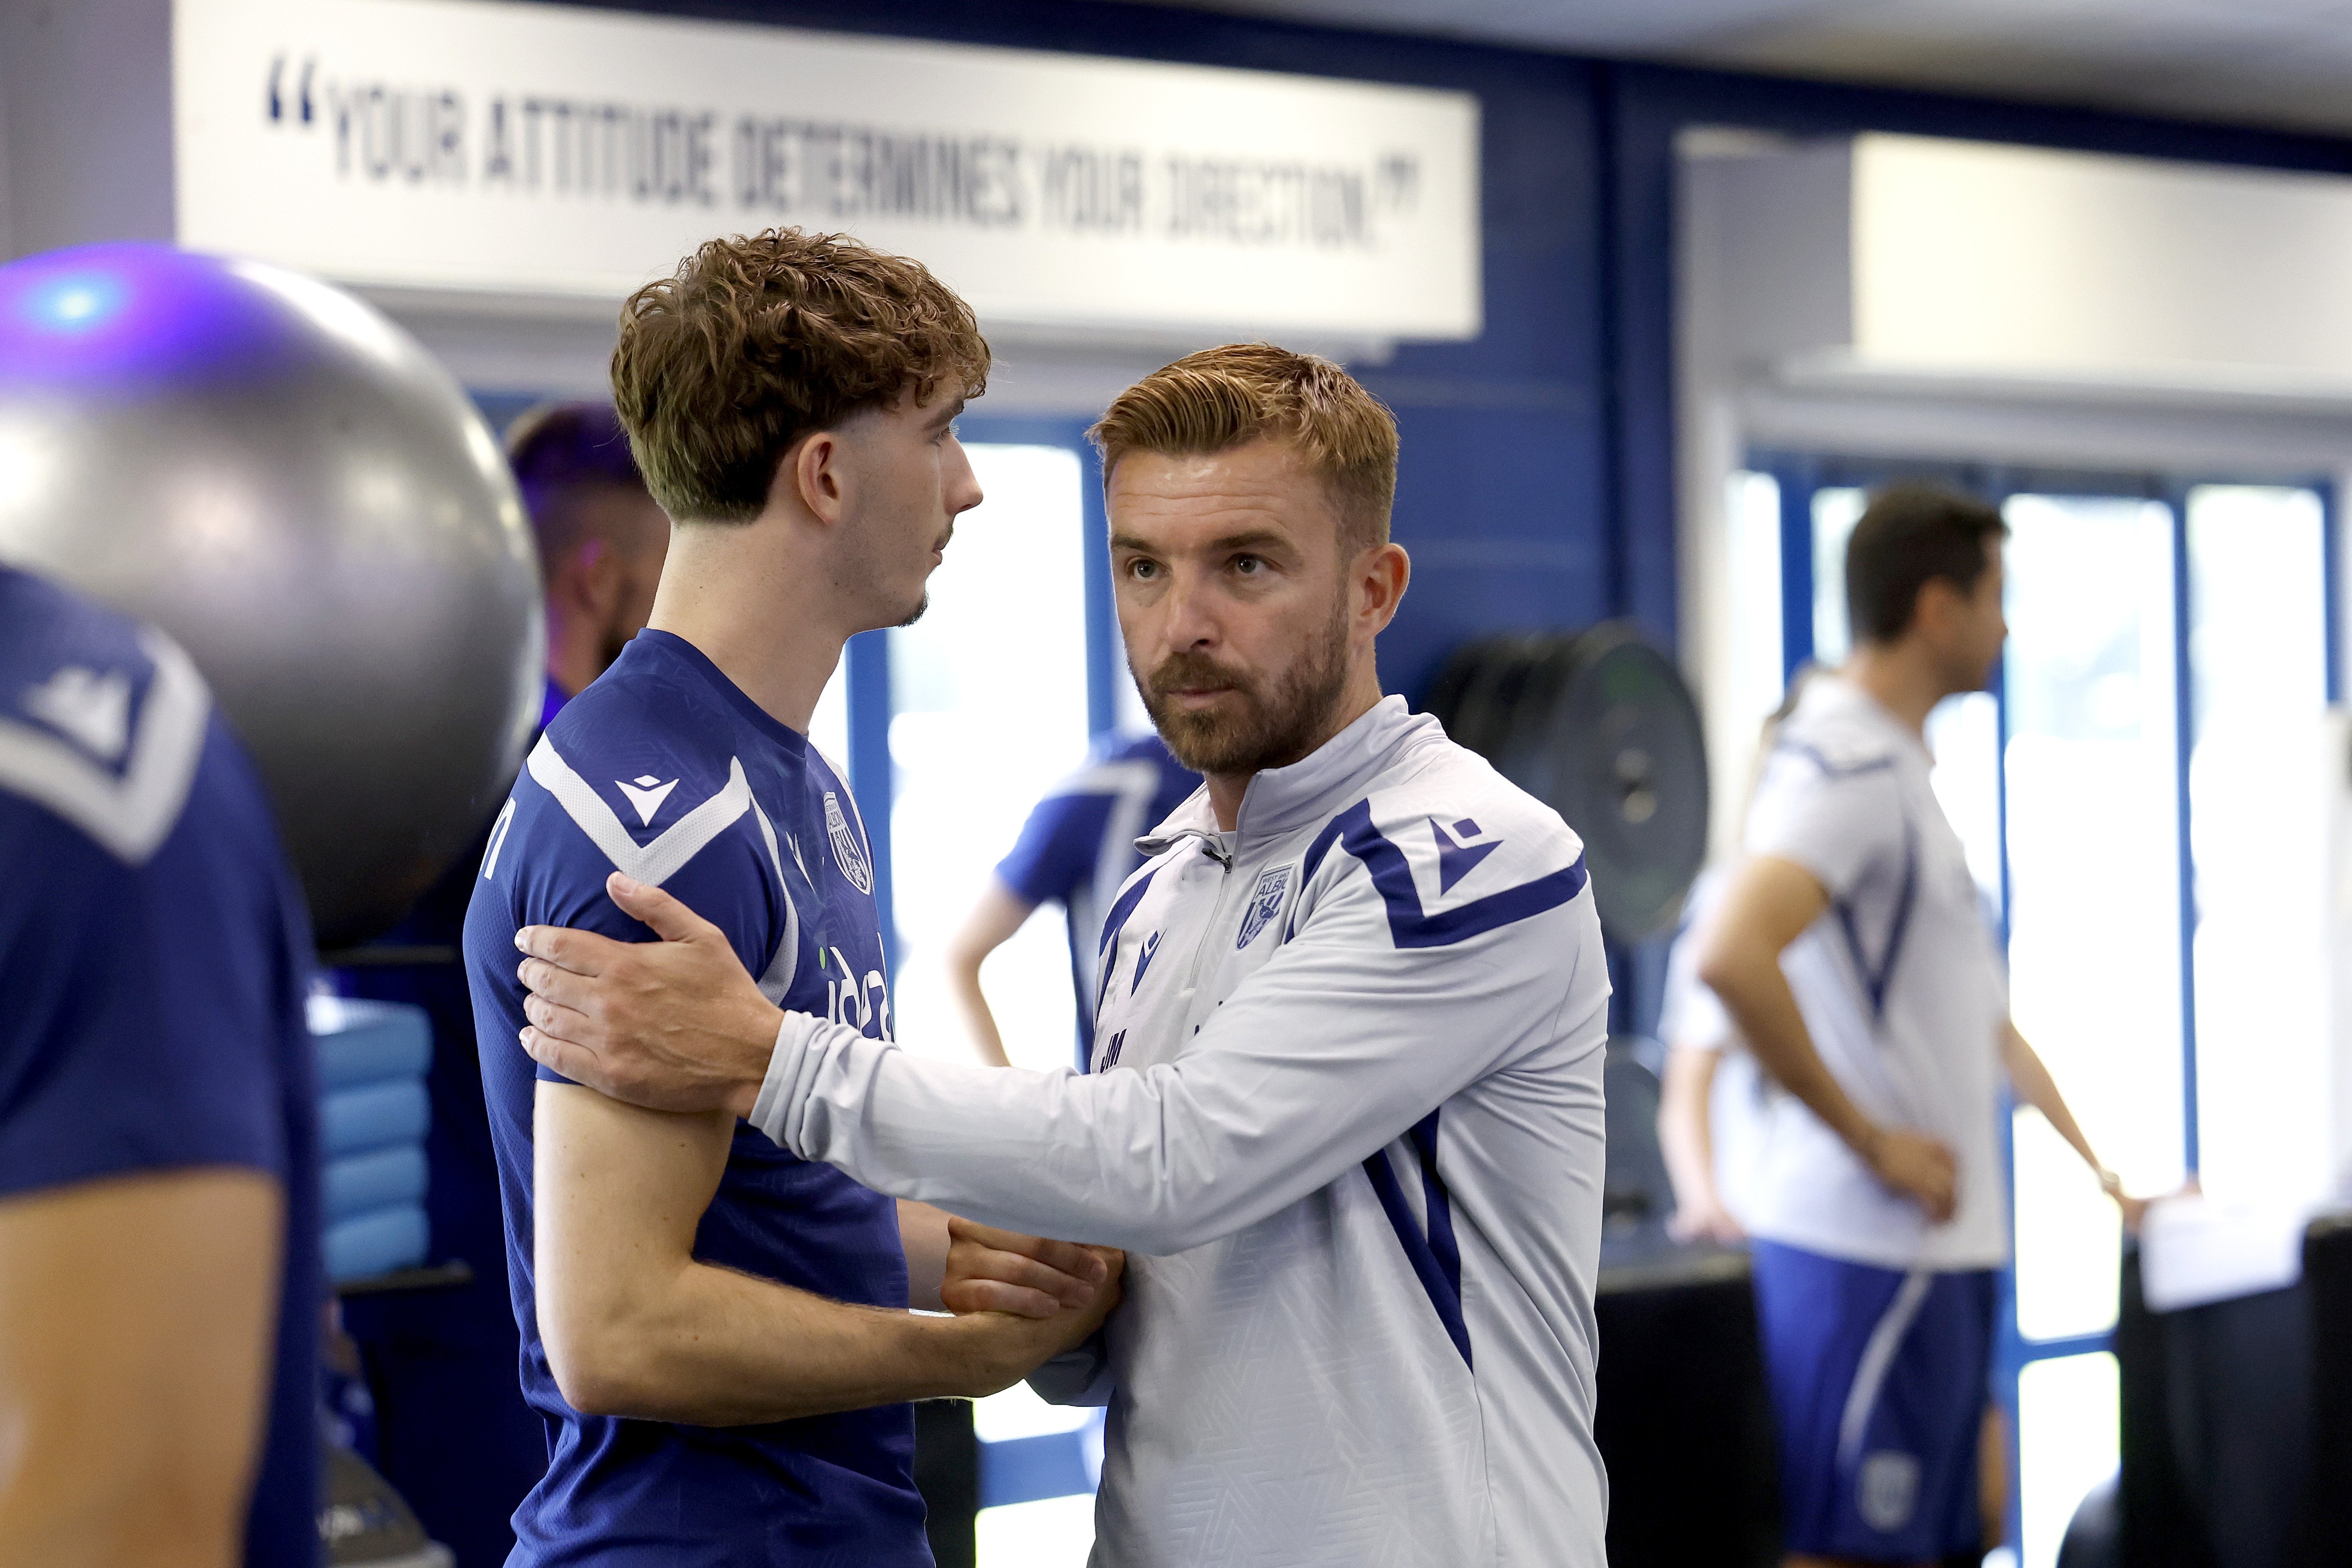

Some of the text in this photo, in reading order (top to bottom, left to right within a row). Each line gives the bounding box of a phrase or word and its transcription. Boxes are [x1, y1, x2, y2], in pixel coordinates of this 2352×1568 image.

[483, 94, 715, 210] ATTITUDE
[731, 117, 1024, 227] DETERMINES
[1029, 146, 1144, 234] YOUR
[1255, 878, 1288, 899] ALBI
[1100, 1028, 1127, 1073] JM
